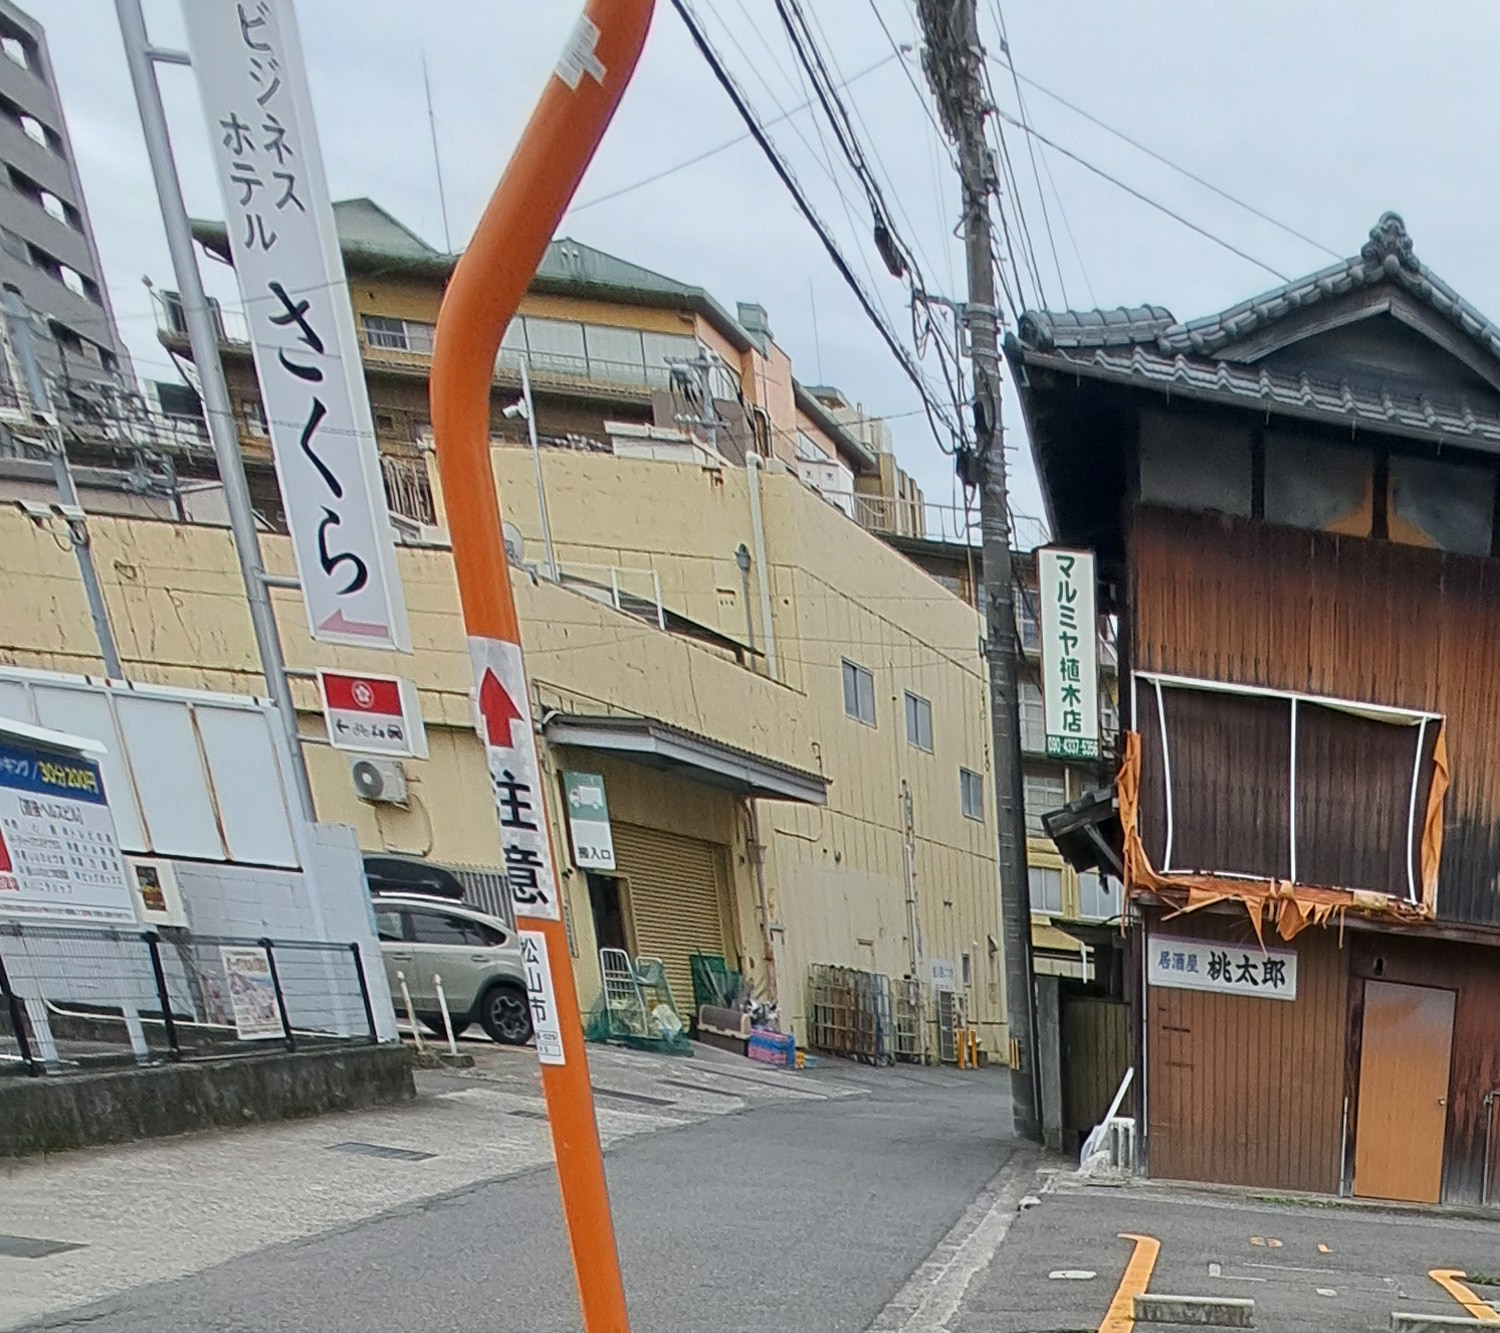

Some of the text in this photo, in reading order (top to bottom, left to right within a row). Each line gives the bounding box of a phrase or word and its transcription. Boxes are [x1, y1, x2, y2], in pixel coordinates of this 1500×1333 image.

[237, 2, 305, 212] ビジネス
[219, 112, 277, 251] ホテル
[268, 281, 369, 595] さくら
[1055, 554, 1083, 733] マルミヤ植木店
[491, 769, 549, 904] 注意
[520, 938, 546, 1023] 松山市
[1158, 951, 1286, 989] 居酒屋 桃太郎
